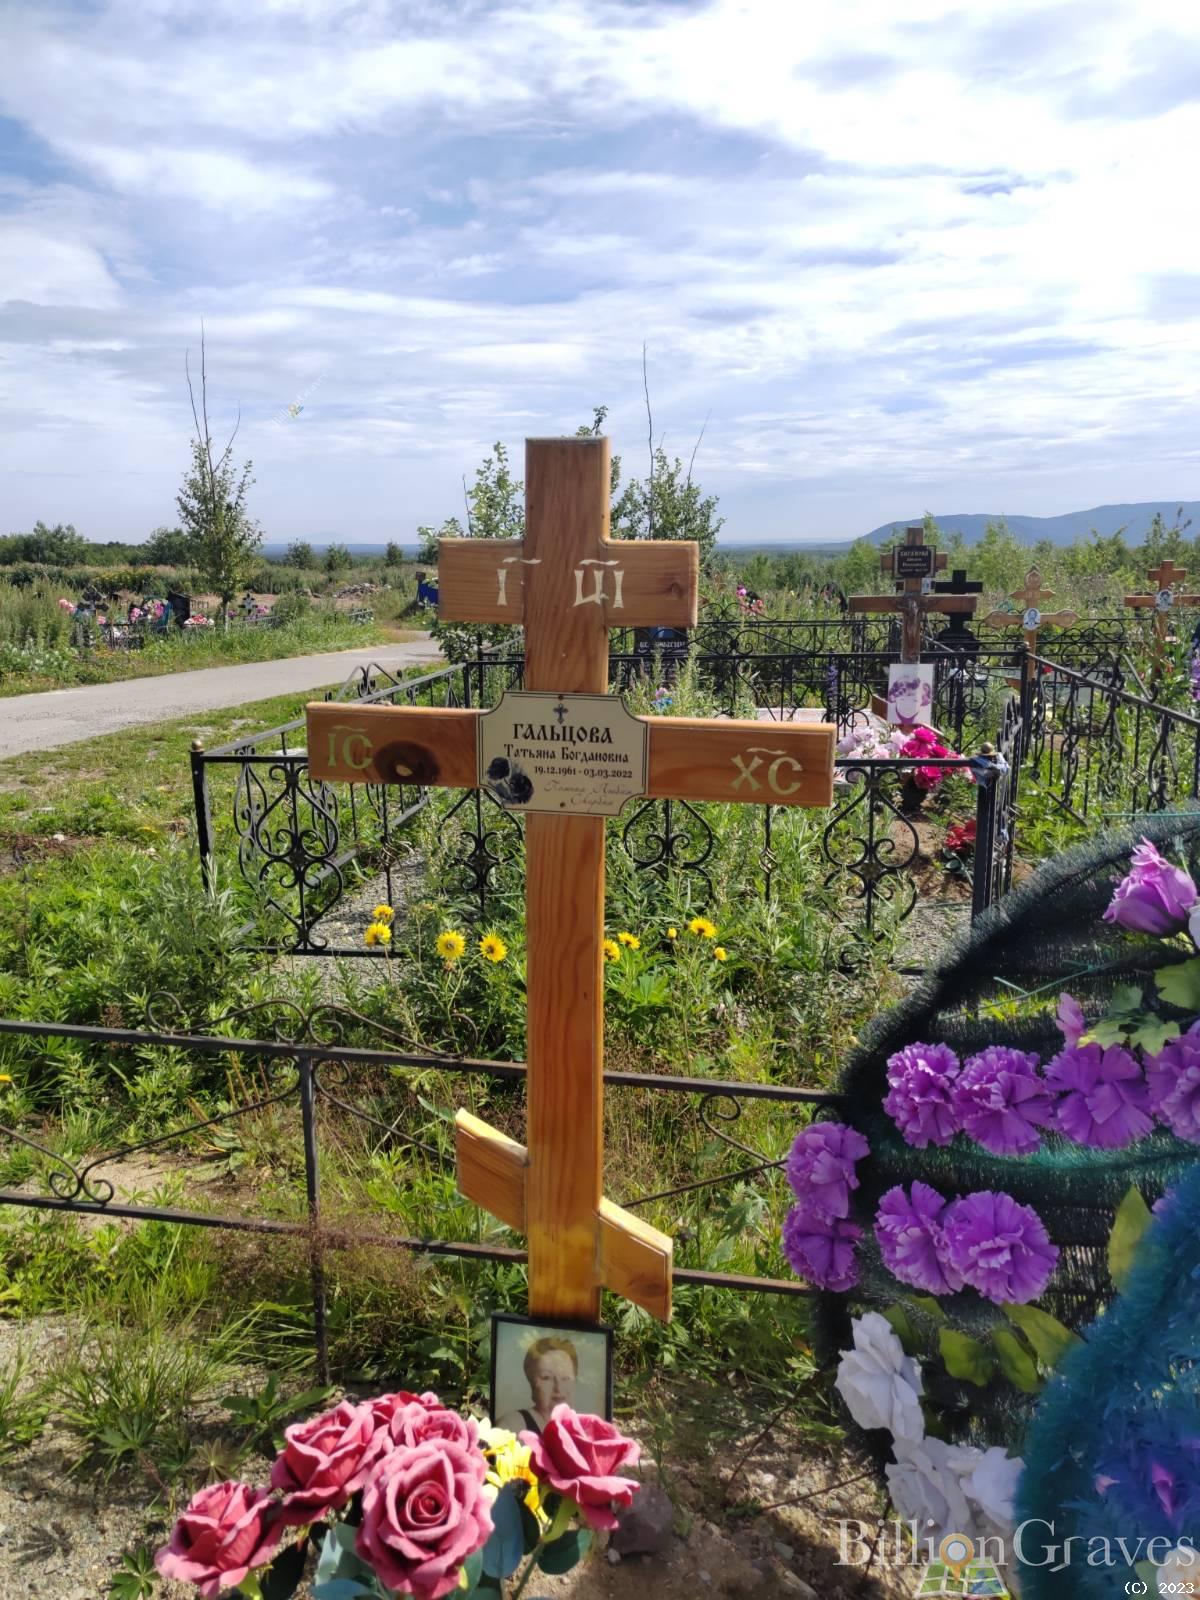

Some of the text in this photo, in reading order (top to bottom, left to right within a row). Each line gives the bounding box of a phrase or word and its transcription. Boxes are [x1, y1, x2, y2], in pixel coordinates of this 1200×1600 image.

[512, 723, 613, 746] ГАЛЬЦОВА
[504, 743, 629, 764] Татьяна Богдановна
[534, 765, 576, 777] 19.12.1961
[583, 767, 633, 779] 03.03.2022
